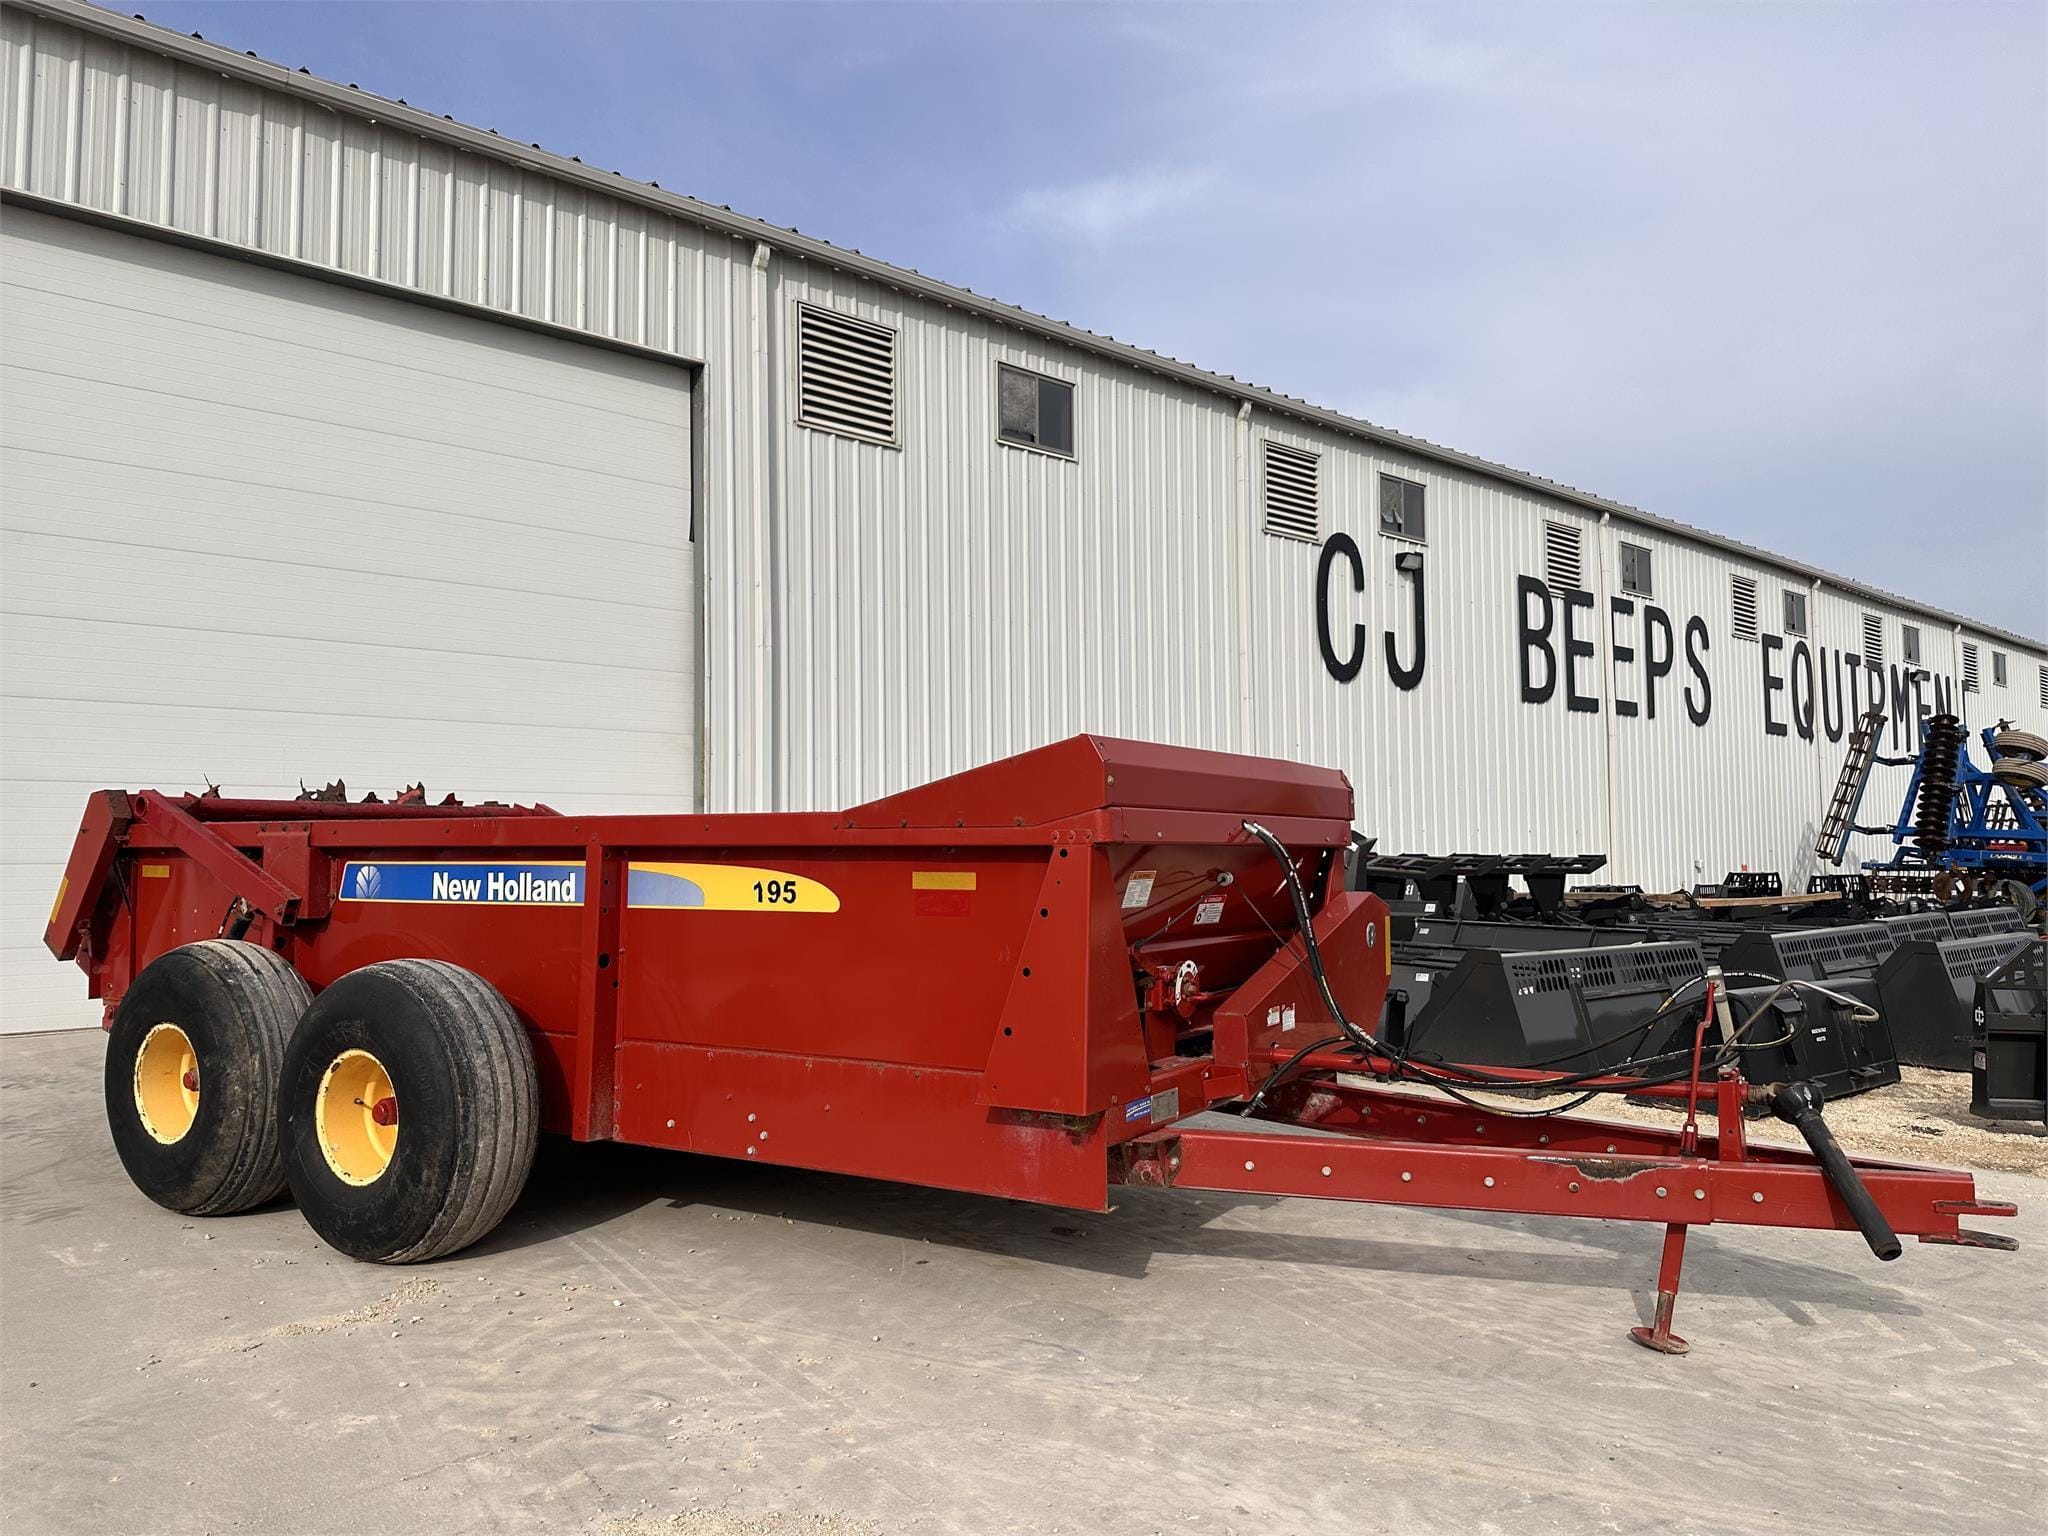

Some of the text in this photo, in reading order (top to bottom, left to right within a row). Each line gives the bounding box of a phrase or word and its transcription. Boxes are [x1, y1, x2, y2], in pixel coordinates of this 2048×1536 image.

[1317, 532, 1425, 691] CJ
[1518, 574, 1712, 727] BEEPS
[432, 871, 576, 902] New Holland
[753, 880, 797, 904] 195
